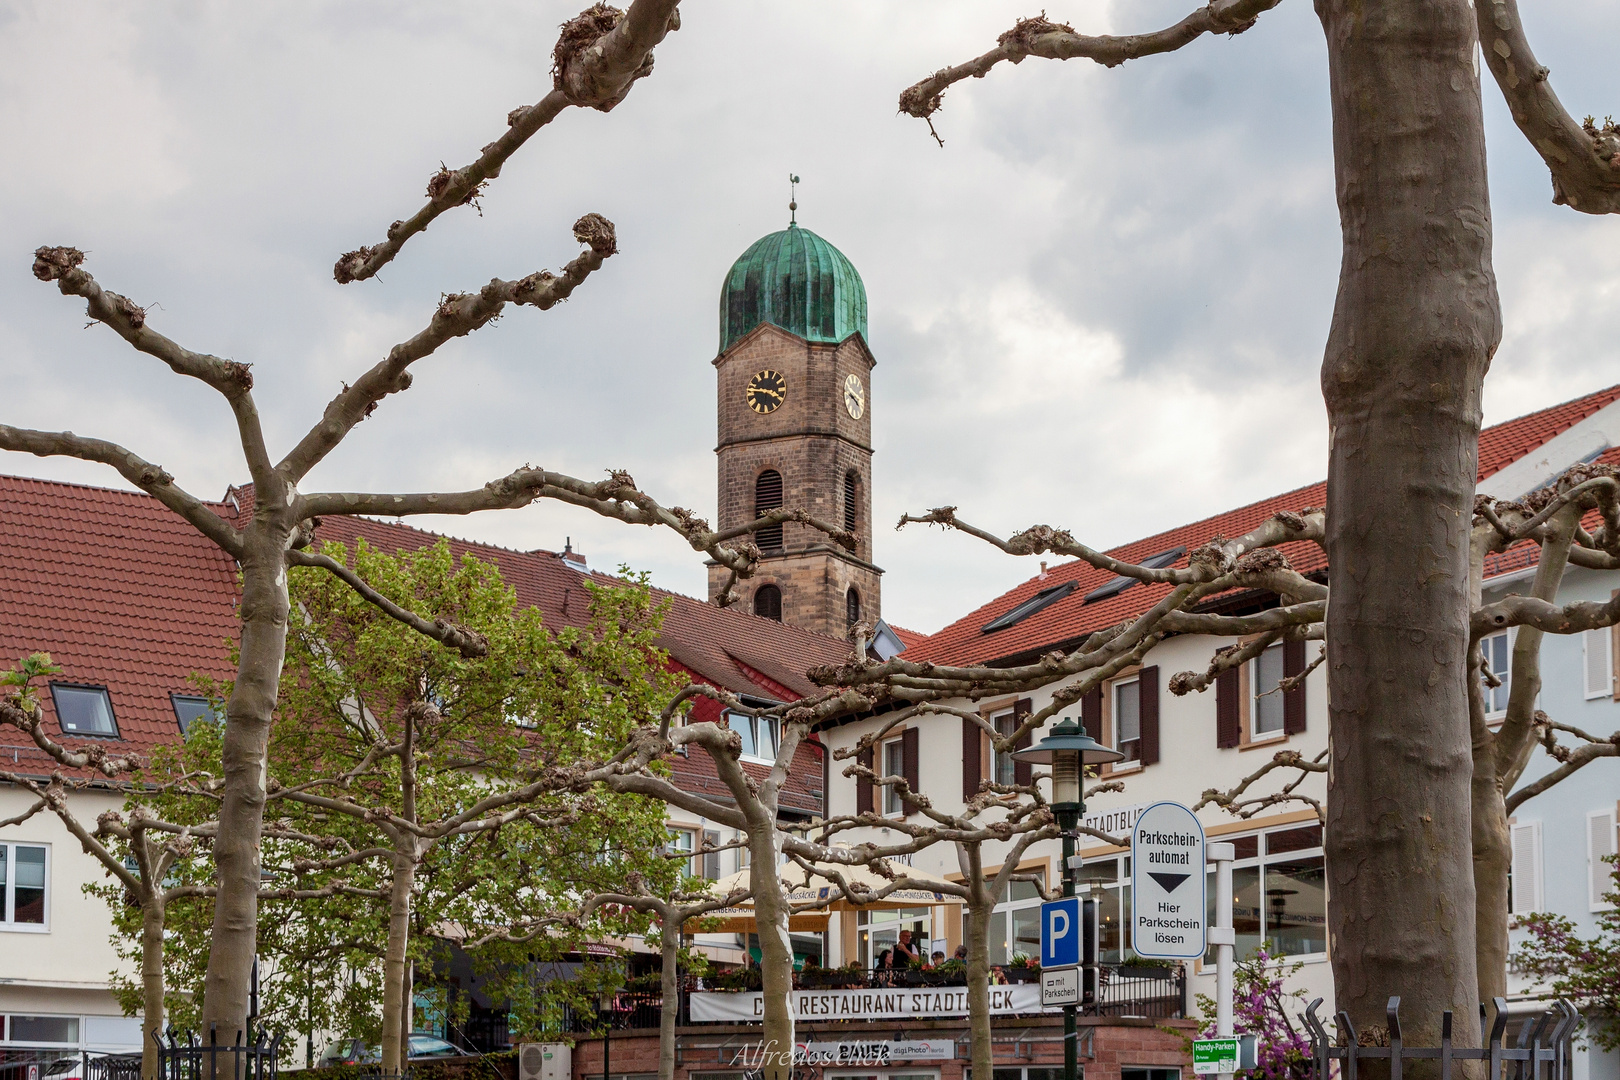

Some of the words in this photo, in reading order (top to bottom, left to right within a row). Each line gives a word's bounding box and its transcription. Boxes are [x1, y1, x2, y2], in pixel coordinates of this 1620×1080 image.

[1140, 830, 1200, 847] Parkschein-
[1149, 850, 1189, 865] automat
[1158, 902, 1181, 913] Hier
[1139, 916, 1200, 929] Parkschein
[1050, 909, 1070, 958] P
[1155, 932, 1184, 944] lösen
[1055, 977, 1065, 986] mit
[1045, 985, 1076, 998] Parkschein
[799, 993, 907, 1015] RESTAURANT
[839, 1044, 889, 1059] BAUER
[1195, 1042, 1236, 1053] Handy-Parken
